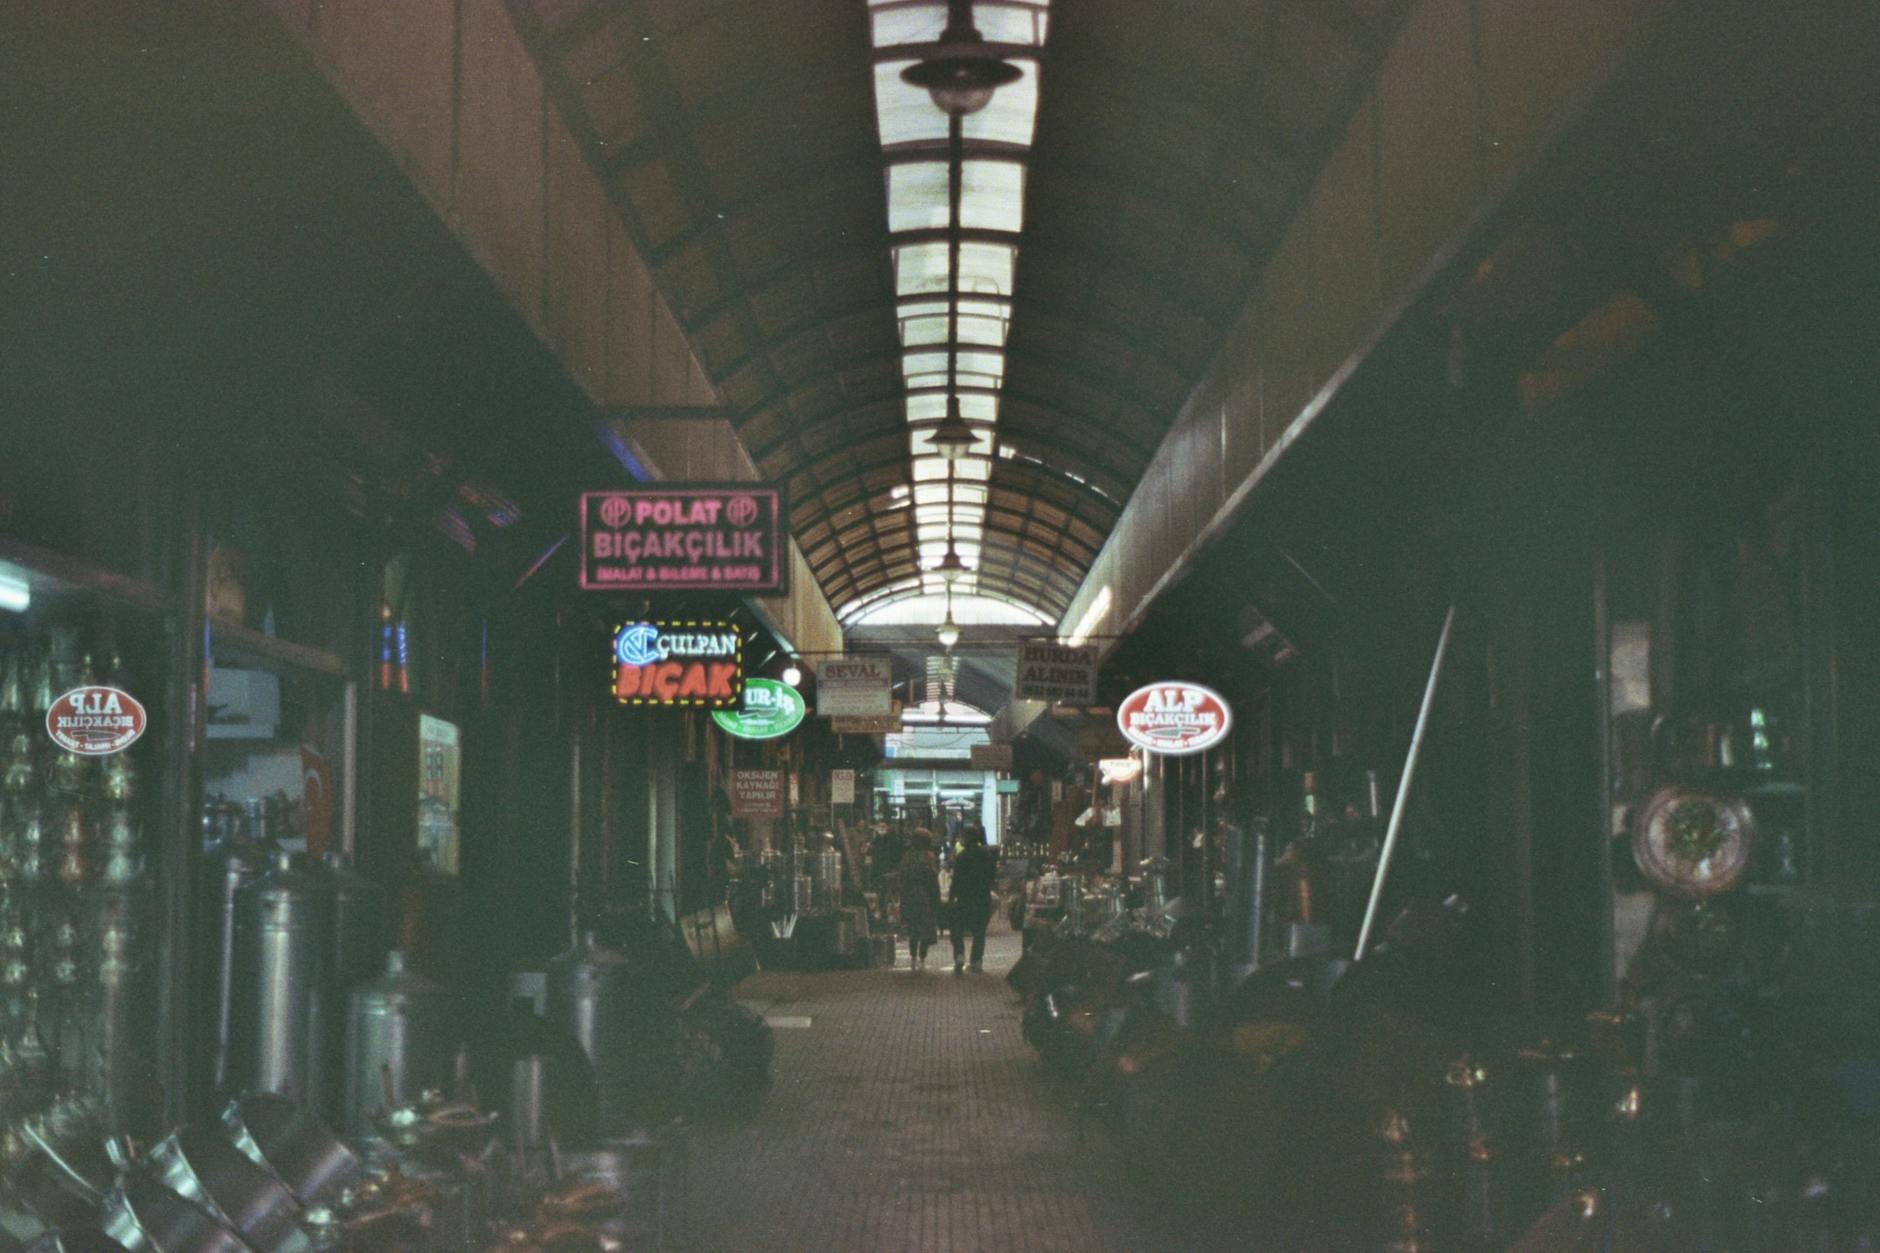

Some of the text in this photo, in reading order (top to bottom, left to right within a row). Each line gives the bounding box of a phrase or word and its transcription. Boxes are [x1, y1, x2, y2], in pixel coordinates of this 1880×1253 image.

[635, 500, 722, 526] POLAT
[617, 663, 738, 702] BIÇAK
[1142, 689, 1206, 712] ALP
